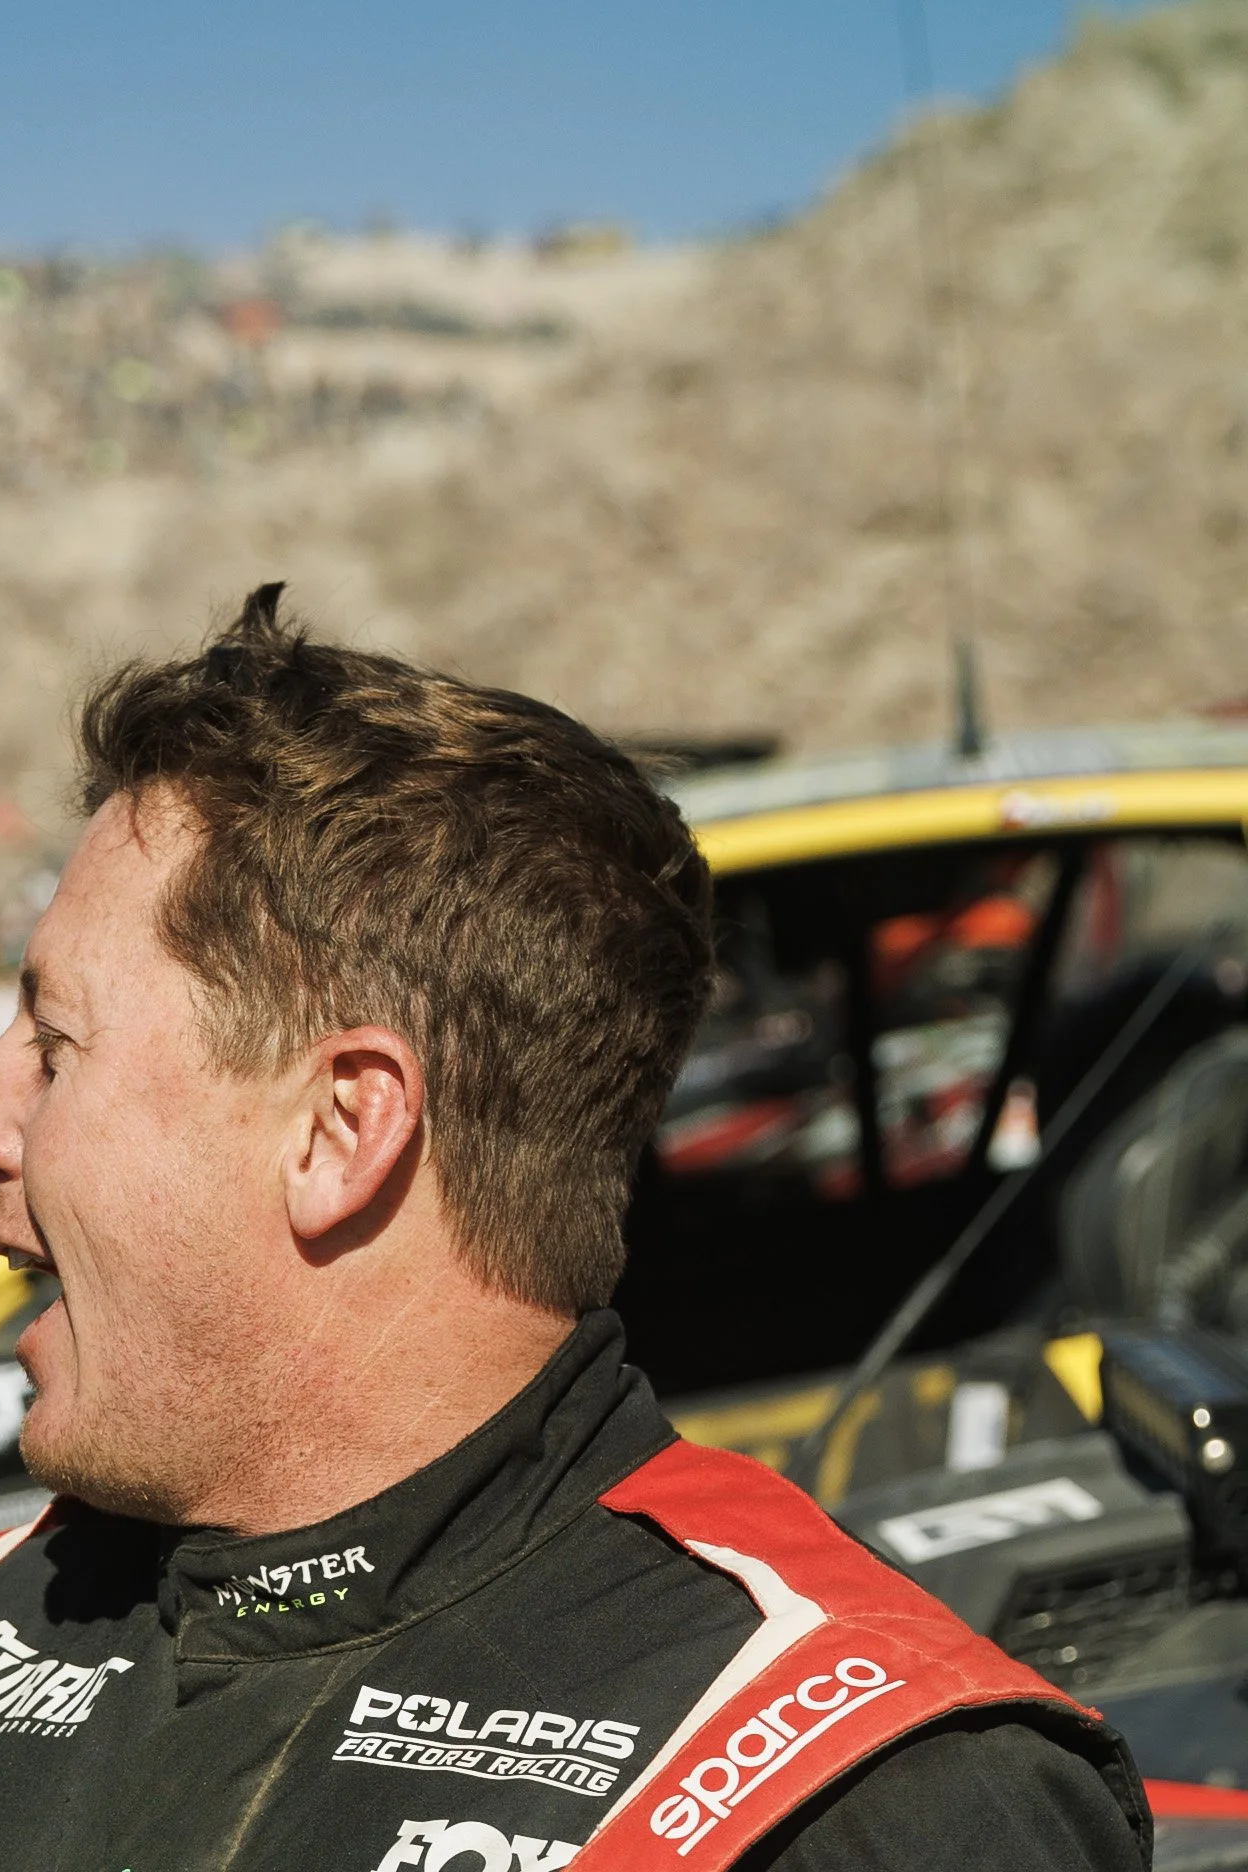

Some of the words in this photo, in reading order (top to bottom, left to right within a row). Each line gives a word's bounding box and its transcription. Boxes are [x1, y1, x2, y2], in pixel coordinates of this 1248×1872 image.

[236, 1587, 349, 1618] ENERGY
[349, 1685, 641, 1760] POLARIS
[650, 1657, 894, 1850] sparco
[340, 1737, 488, 1770] FACTORY
[492, 1754, 619, 1790] RACING
